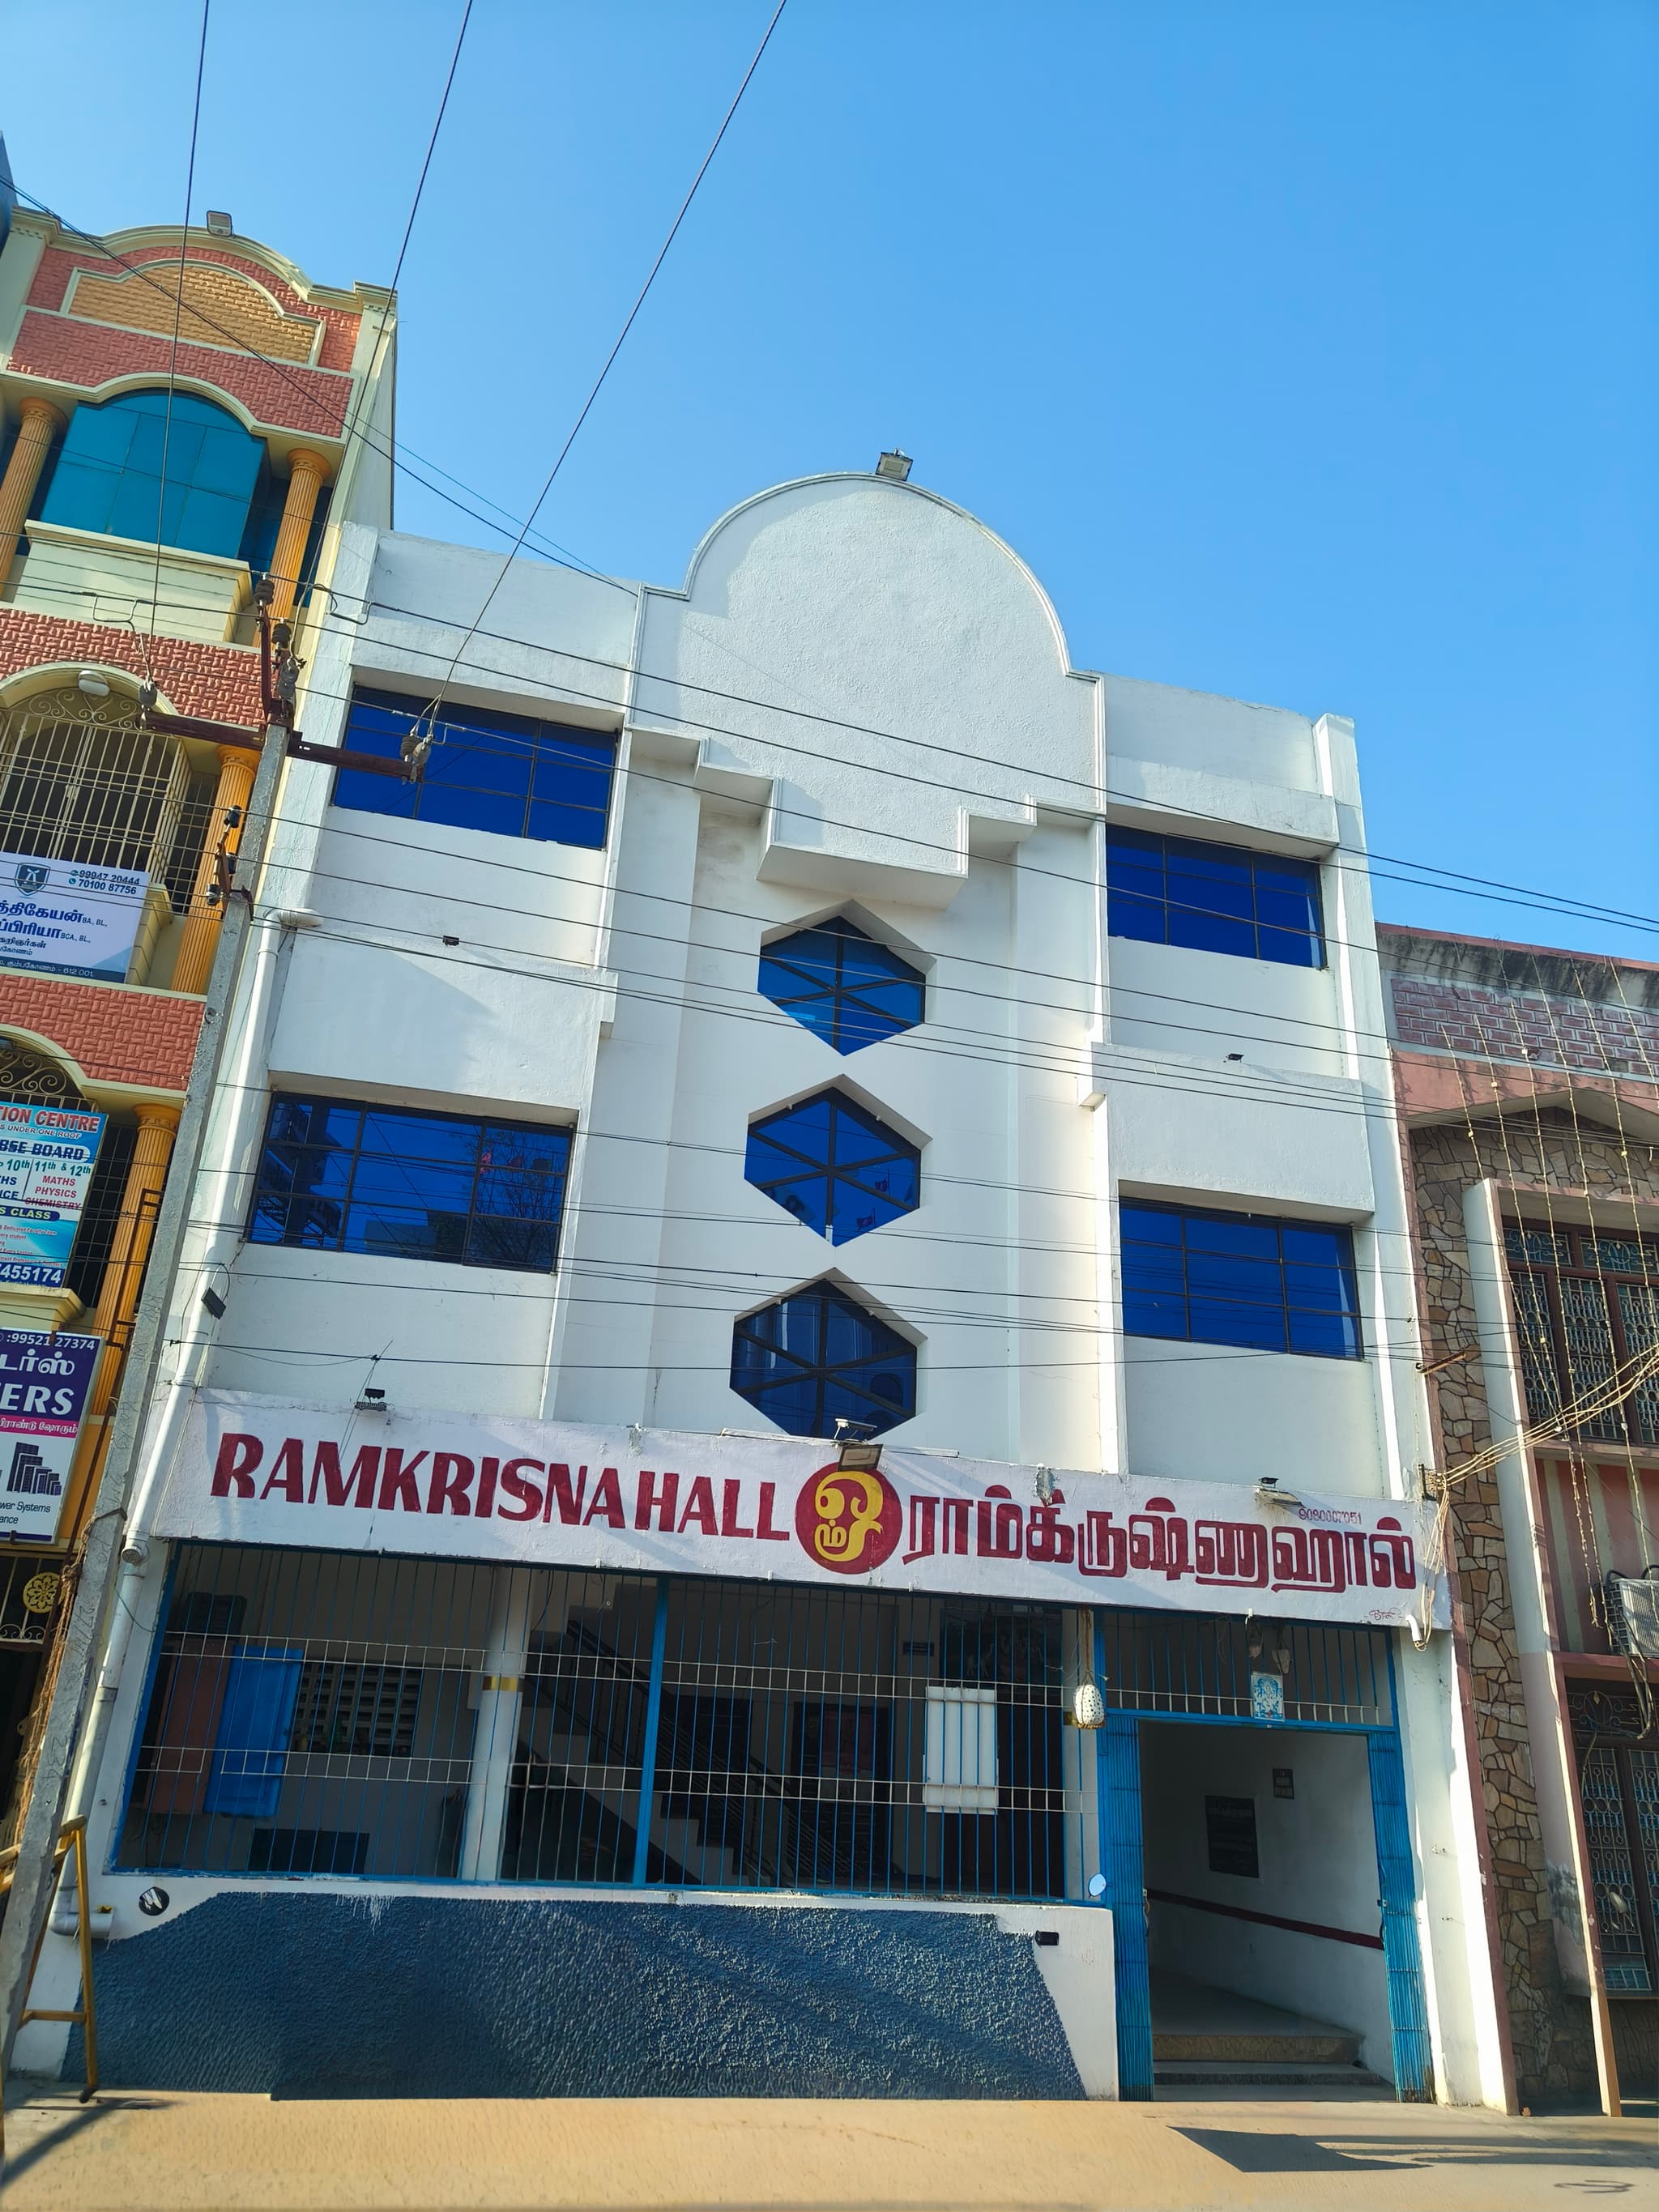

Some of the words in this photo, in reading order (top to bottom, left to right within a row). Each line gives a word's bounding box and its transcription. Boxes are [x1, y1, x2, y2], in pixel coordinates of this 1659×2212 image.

[79, 879, 106, 890] 70100
[108, 884, 137, 894] 87756
[0, 1106, 32, 1123] ION
[35, 1110, 100, 1132] CENTRE
[31, 1143, 84, 1160] BOARD
[7, 1159, 30, 1171] 10th
[35, 1161, 56, 1172] 11th
[70, 1165, 91, 1176] 12th
[0, 1174, 17, 1185] HS
[42, 1175, 75, 1186] MATHS
[35, 1187, 77, 1198] PHYSICS
[11, 1208, 51, 1219] CLASS
[0, 1264, 62, 1284] 455174
[54, 1336, 95, 1350] 27374
[0, 1382, 75, 1415] ERS
[17, 1501, 51, 1513] Systems
